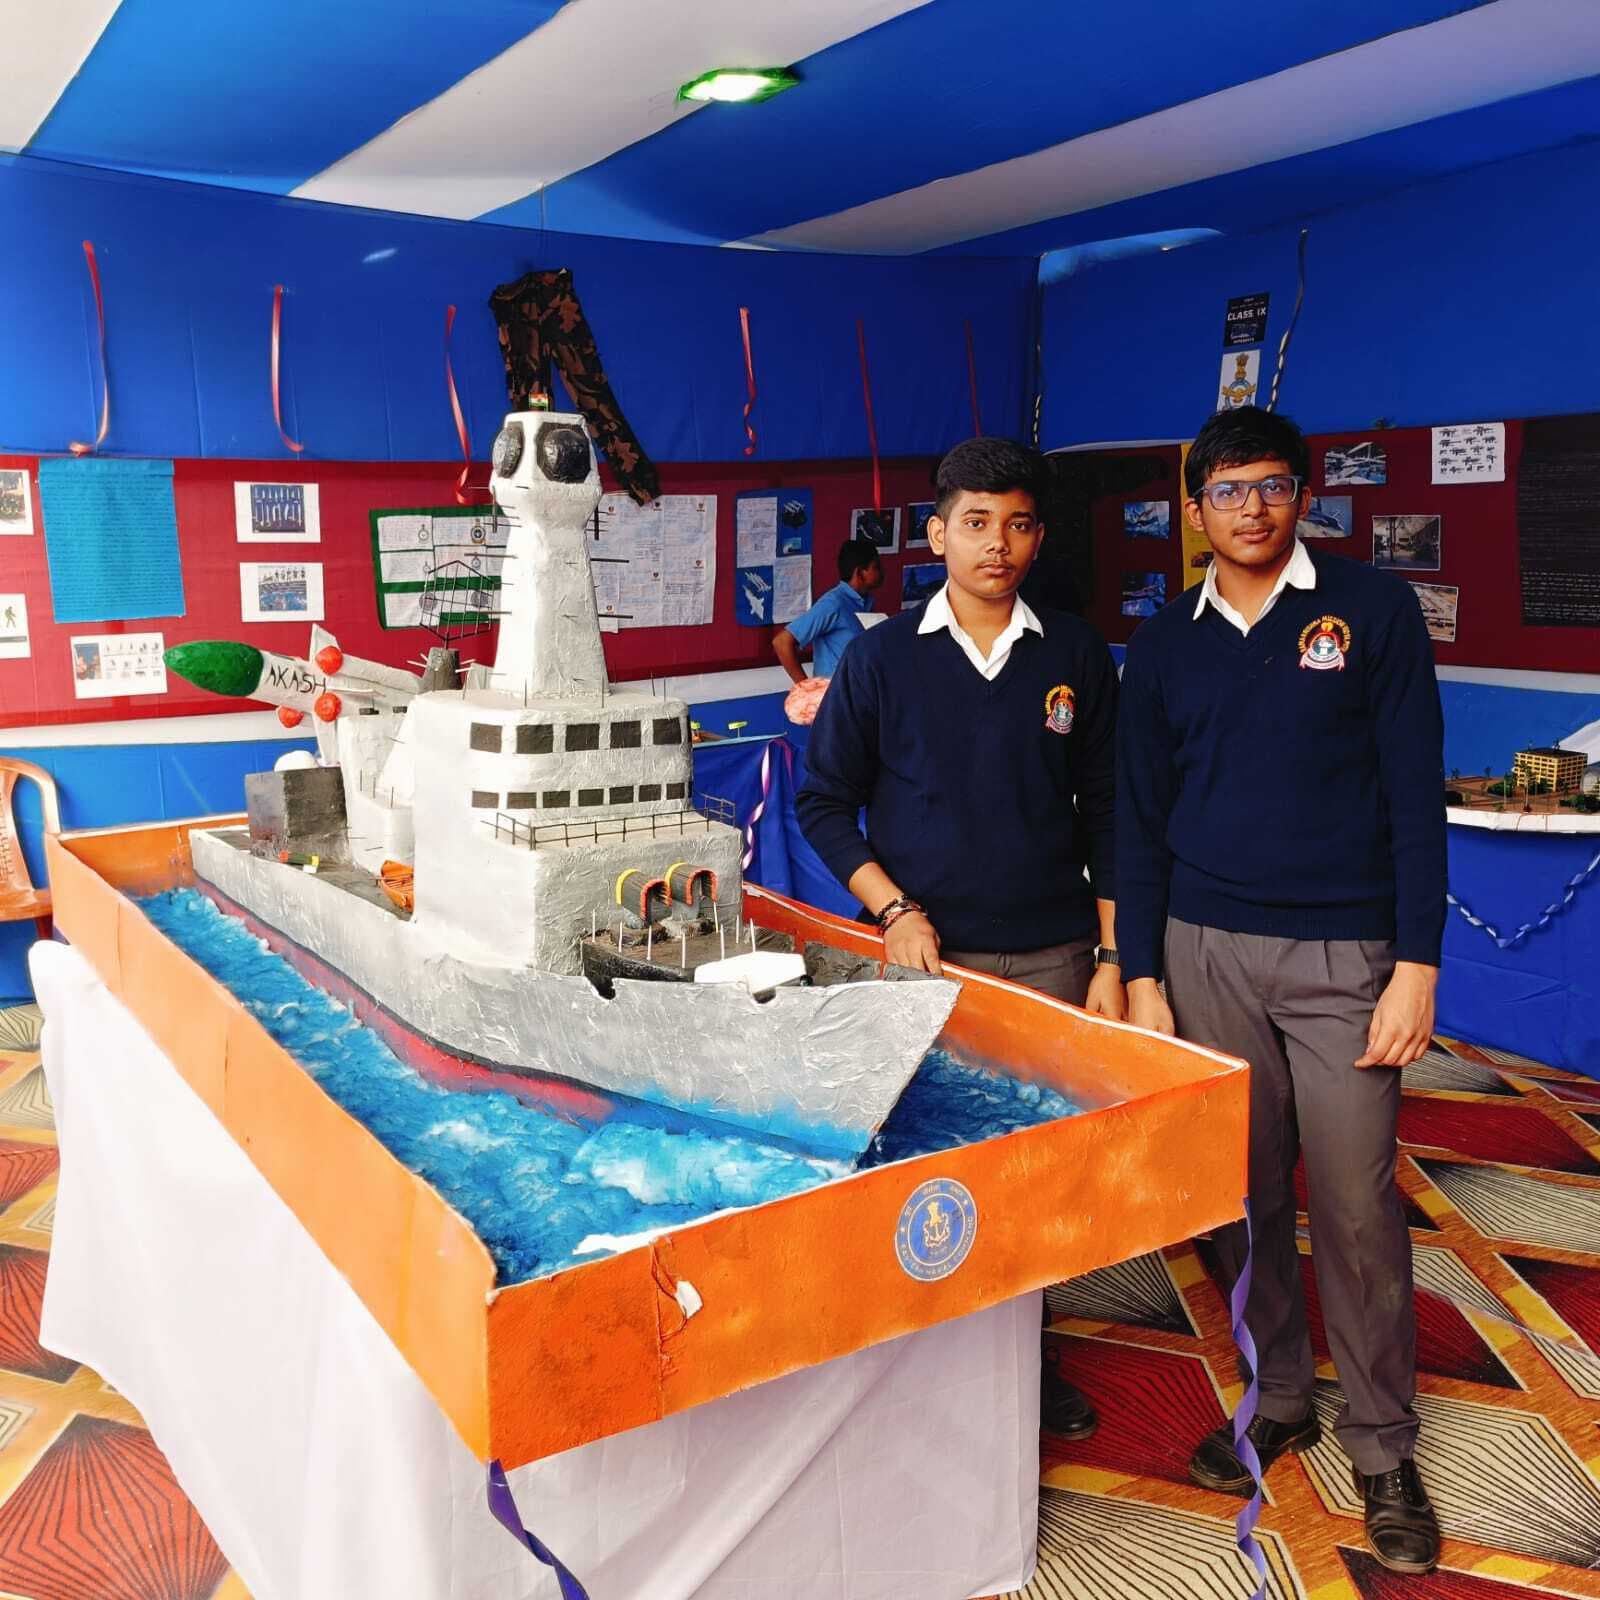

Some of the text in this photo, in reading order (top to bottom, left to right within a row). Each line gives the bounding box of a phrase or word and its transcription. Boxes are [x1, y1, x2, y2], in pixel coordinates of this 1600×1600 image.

[1227, 307, 1266, 321] CLASS IX
[265, 663, 326, 694] AKASH
